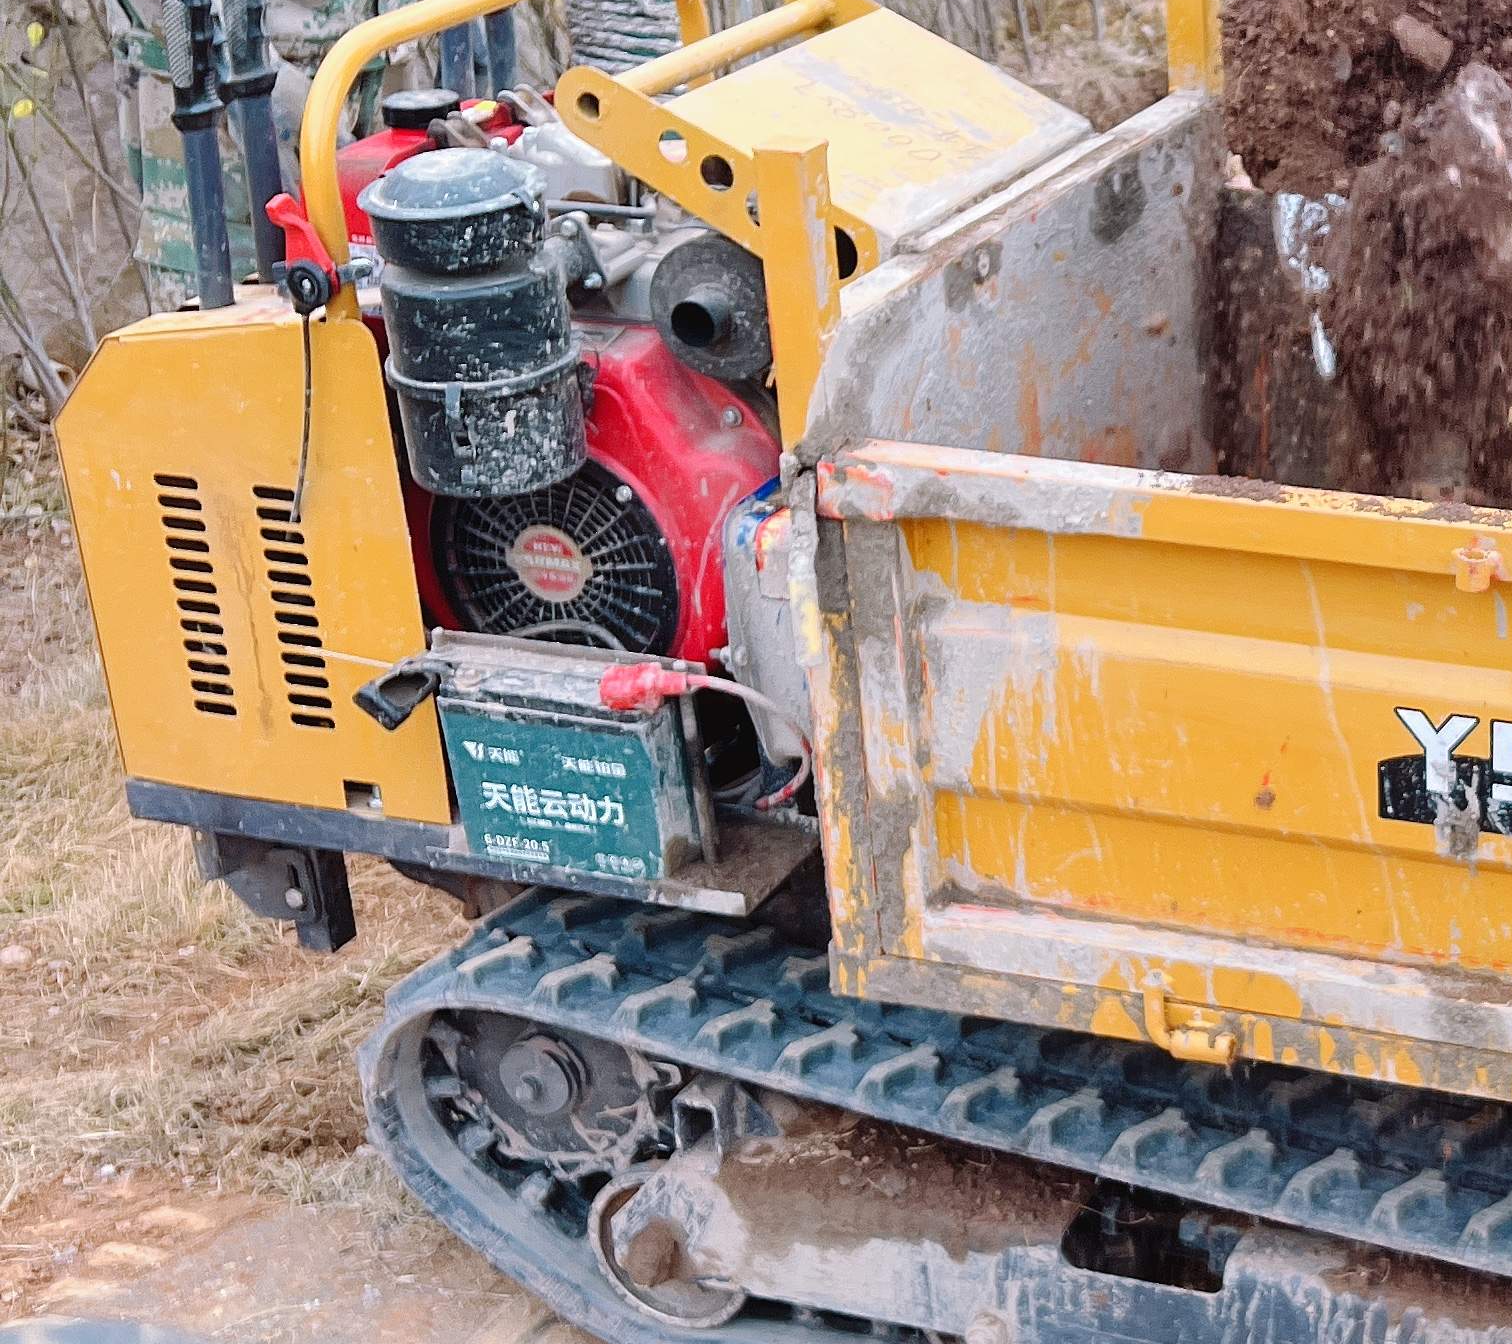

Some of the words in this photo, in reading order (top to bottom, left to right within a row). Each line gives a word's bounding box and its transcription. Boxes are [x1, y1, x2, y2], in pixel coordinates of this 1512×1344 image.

[481, 781, 625, 826] 天能云动力
